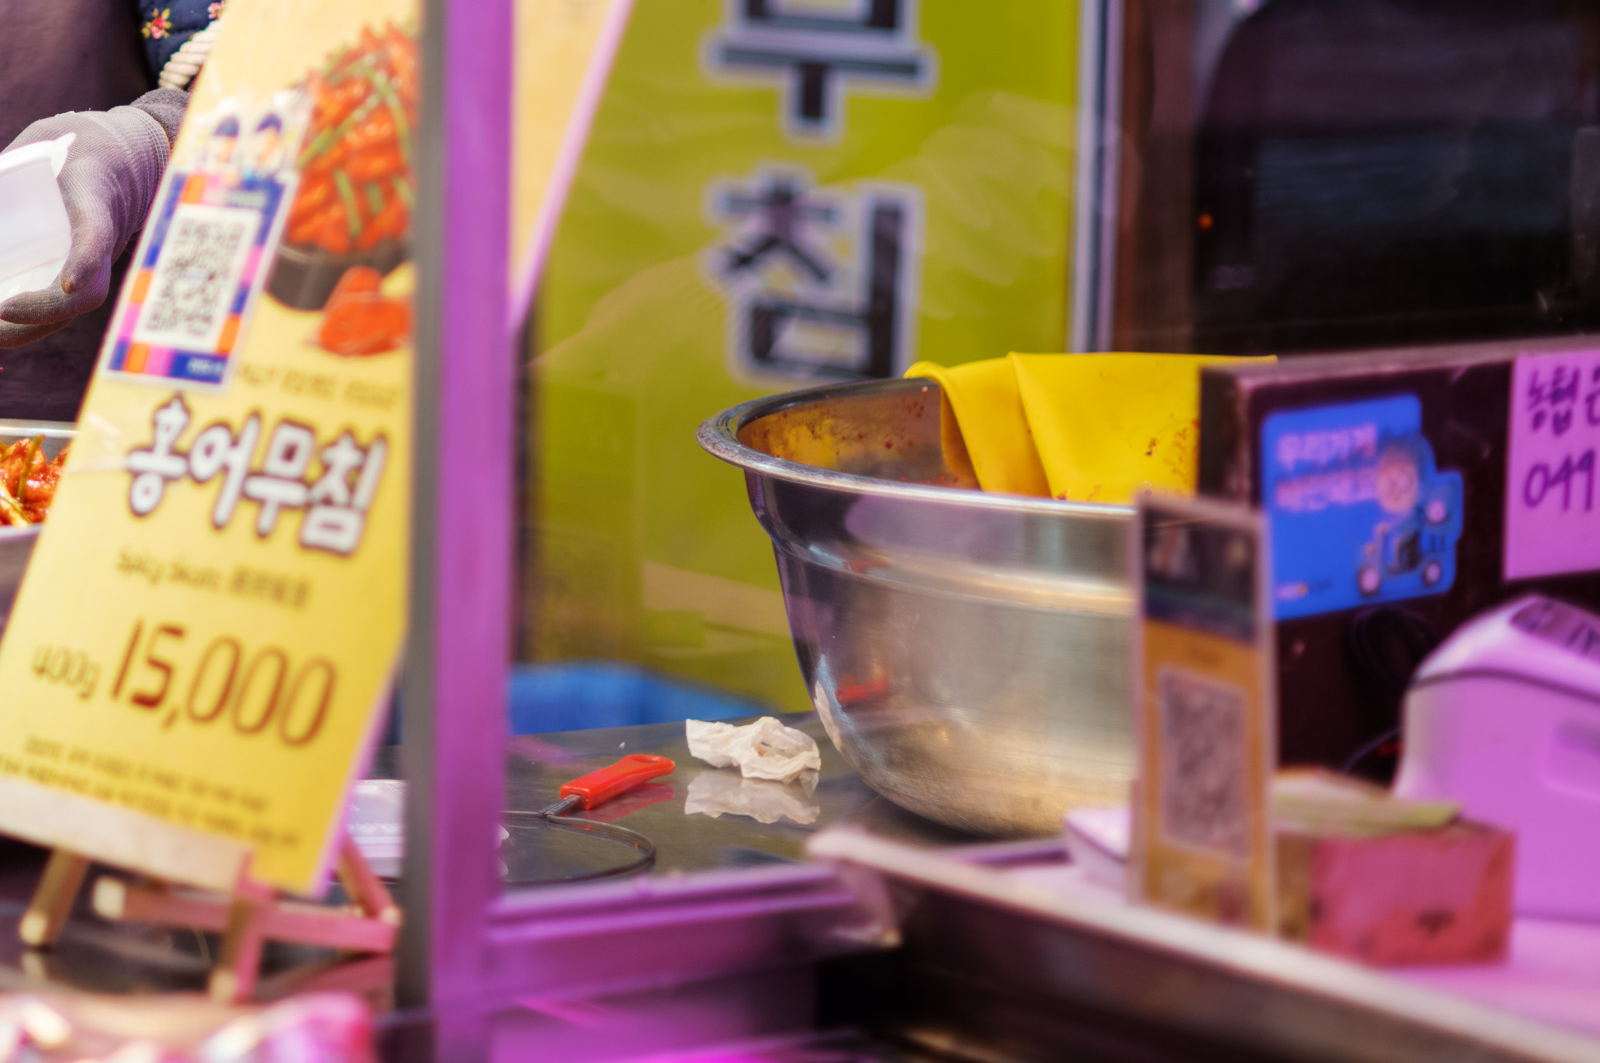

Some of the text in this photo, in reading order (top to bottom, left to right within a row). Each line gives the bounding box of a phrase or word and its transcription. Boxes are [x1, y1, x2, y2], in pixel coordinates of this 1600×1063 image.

[122, 391, 390, 562] 홍어무침
[31, 614, 339, 749] 400g 15,000
